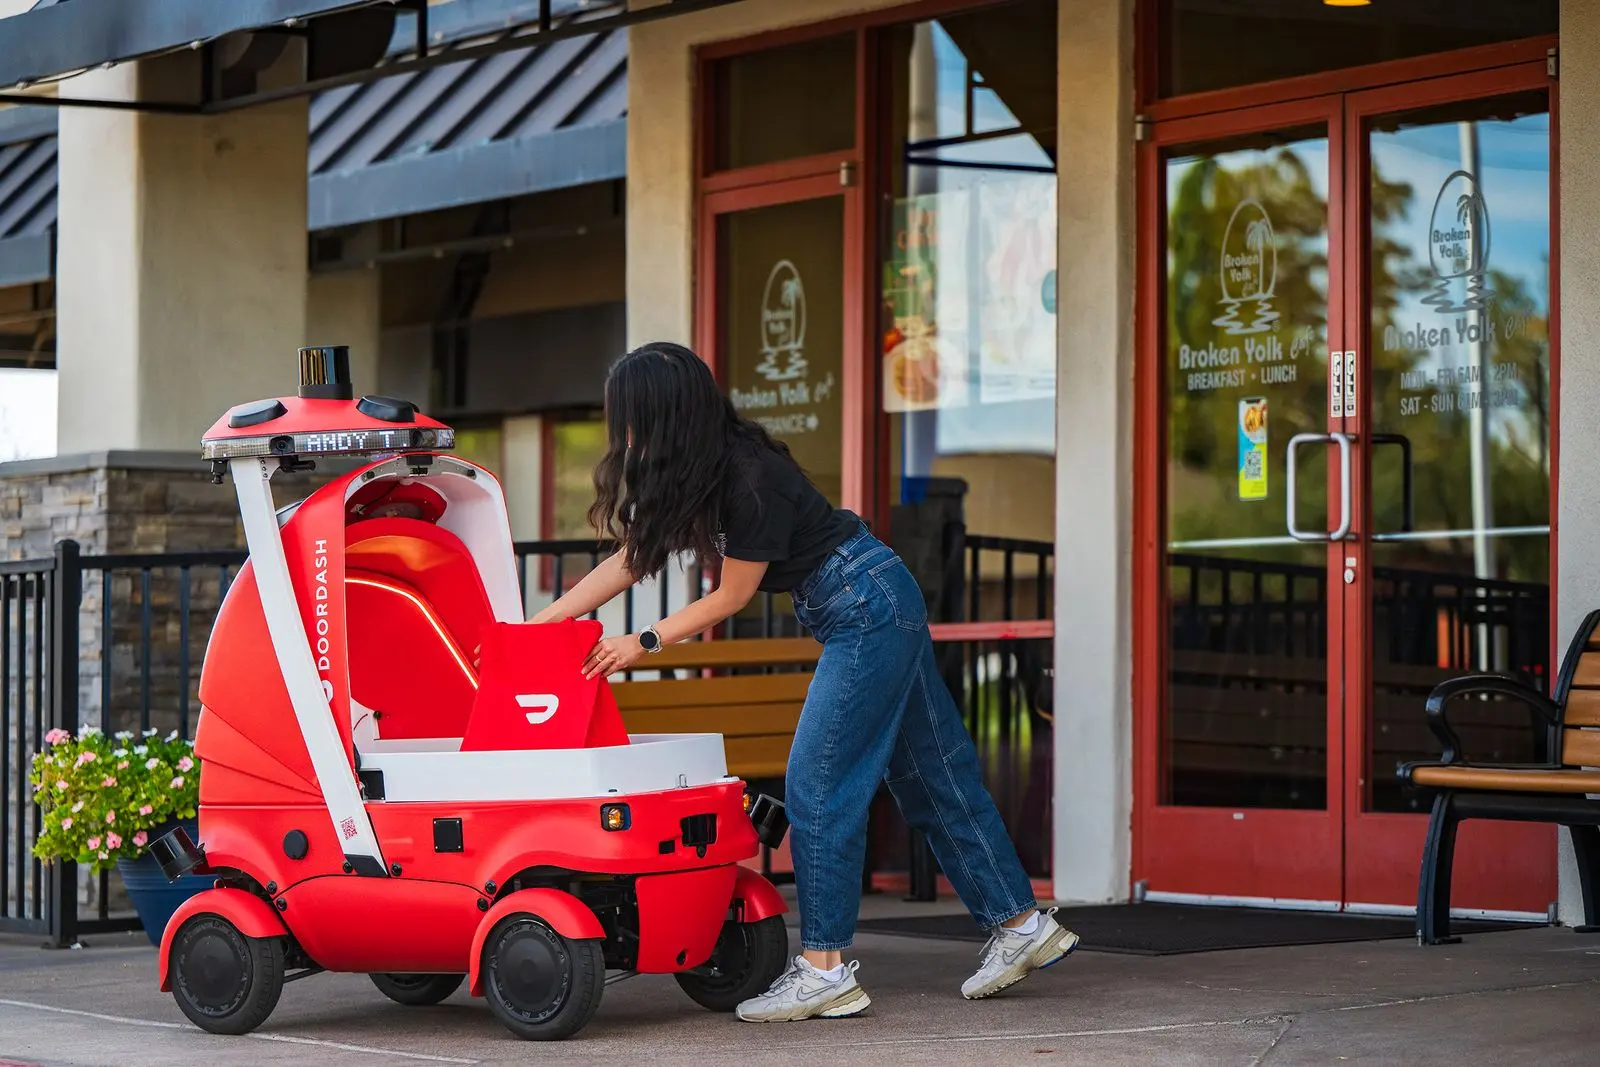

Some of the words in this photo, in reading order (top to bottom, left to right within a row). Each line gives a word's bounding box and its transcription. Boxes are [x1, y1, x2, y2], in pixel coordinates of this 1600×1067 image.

[1433, 227, 1470, 243] Broken
[1225, 253, 1259, 268] Broken
[1455, 315, 1496, 344] Yolk
[1179, 341, 1240, 369] Broken
[1244, 335, 1283, 364] Yolk
[1187, 368, 1246, 391] BREAKFAST
[1261, 364, 1297, 384] LUNCH
[1400, 396, 1421, 416] SAT
[1431, 392, 1454, 413] SUN
[307, 432, 369, 452] ANDY
[315, 539, 331, 671] DOORDASH
